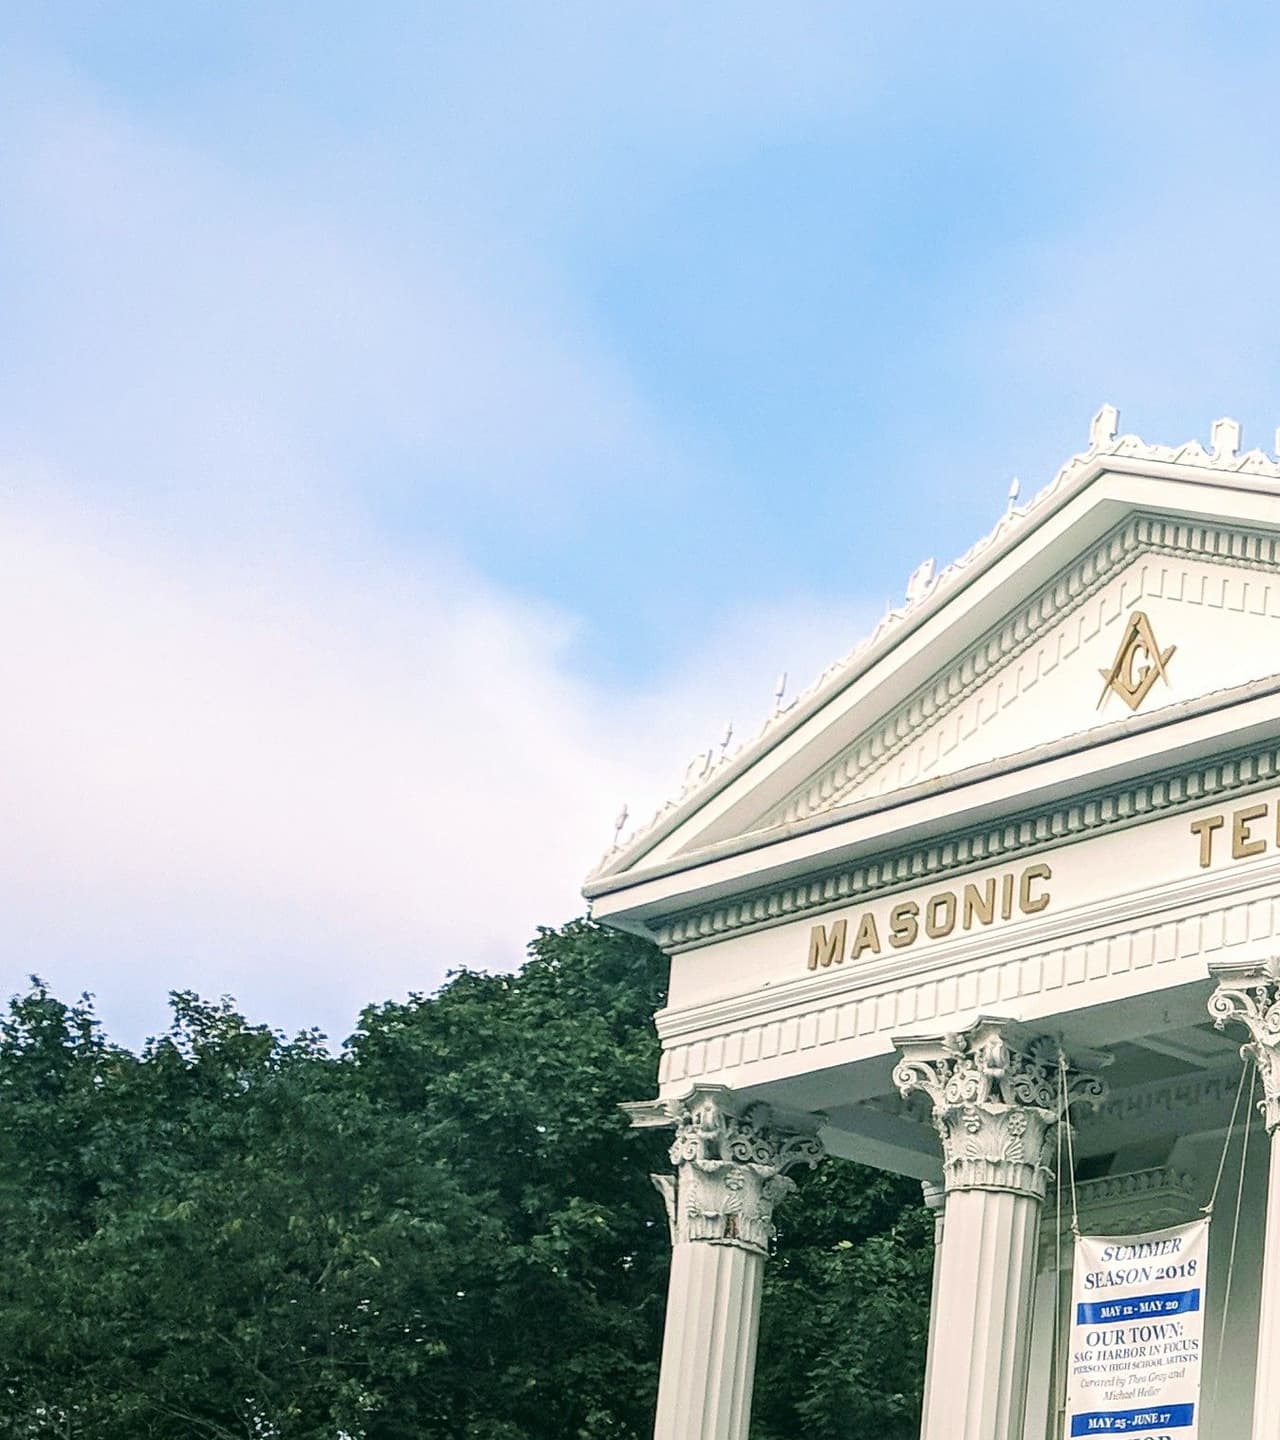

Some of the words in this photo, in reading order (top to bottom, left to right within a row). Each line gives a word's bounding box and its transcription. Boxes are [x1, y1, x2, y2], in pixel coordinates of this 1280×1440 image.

[807, 863, 1052, 971] MASONIC
[1101, 1238, 1182, 1262] SUMMER
[1084, 1266, 1153, 1289] SEASON
[1156, 1259, 1197, 1280] 2018
[1101, 1306, 1120, 1318] MAY
[1140, 1301, 1164, 1312] MAY
[1166, 1301, 1178, 1310] 20
[1086, 1329, 1125, 1347] OUR
[1129, 1322, 1183, 1343] TOWN:
[1074, 1351, 1093, 1363] SAG
[1097, 1346, 1146, 1361] HARBOR
[1150, 1344, 1162, 1356] IN
[1164, 1339, 1198, 1354] FOCUS
[1074, 1364, 1106, 1374] PIERSON
[1109, 1362, 1131, 1371] HIGH
[1132, 1359, 1165, 1370] SCHOOL
[1166, 1354, 1198, 1365] ARTISTS
[1115, 1375, 1125, 1387] by
[1168, 1368, 1185, 1378] and
[1103, 1389, 1135, 1401] Michael
[1088, 1418, 1113, 1429] MAY
[1132, 1414, 1159, 1425] JUNE
[1160, 1414, 1170, 1424] 17
